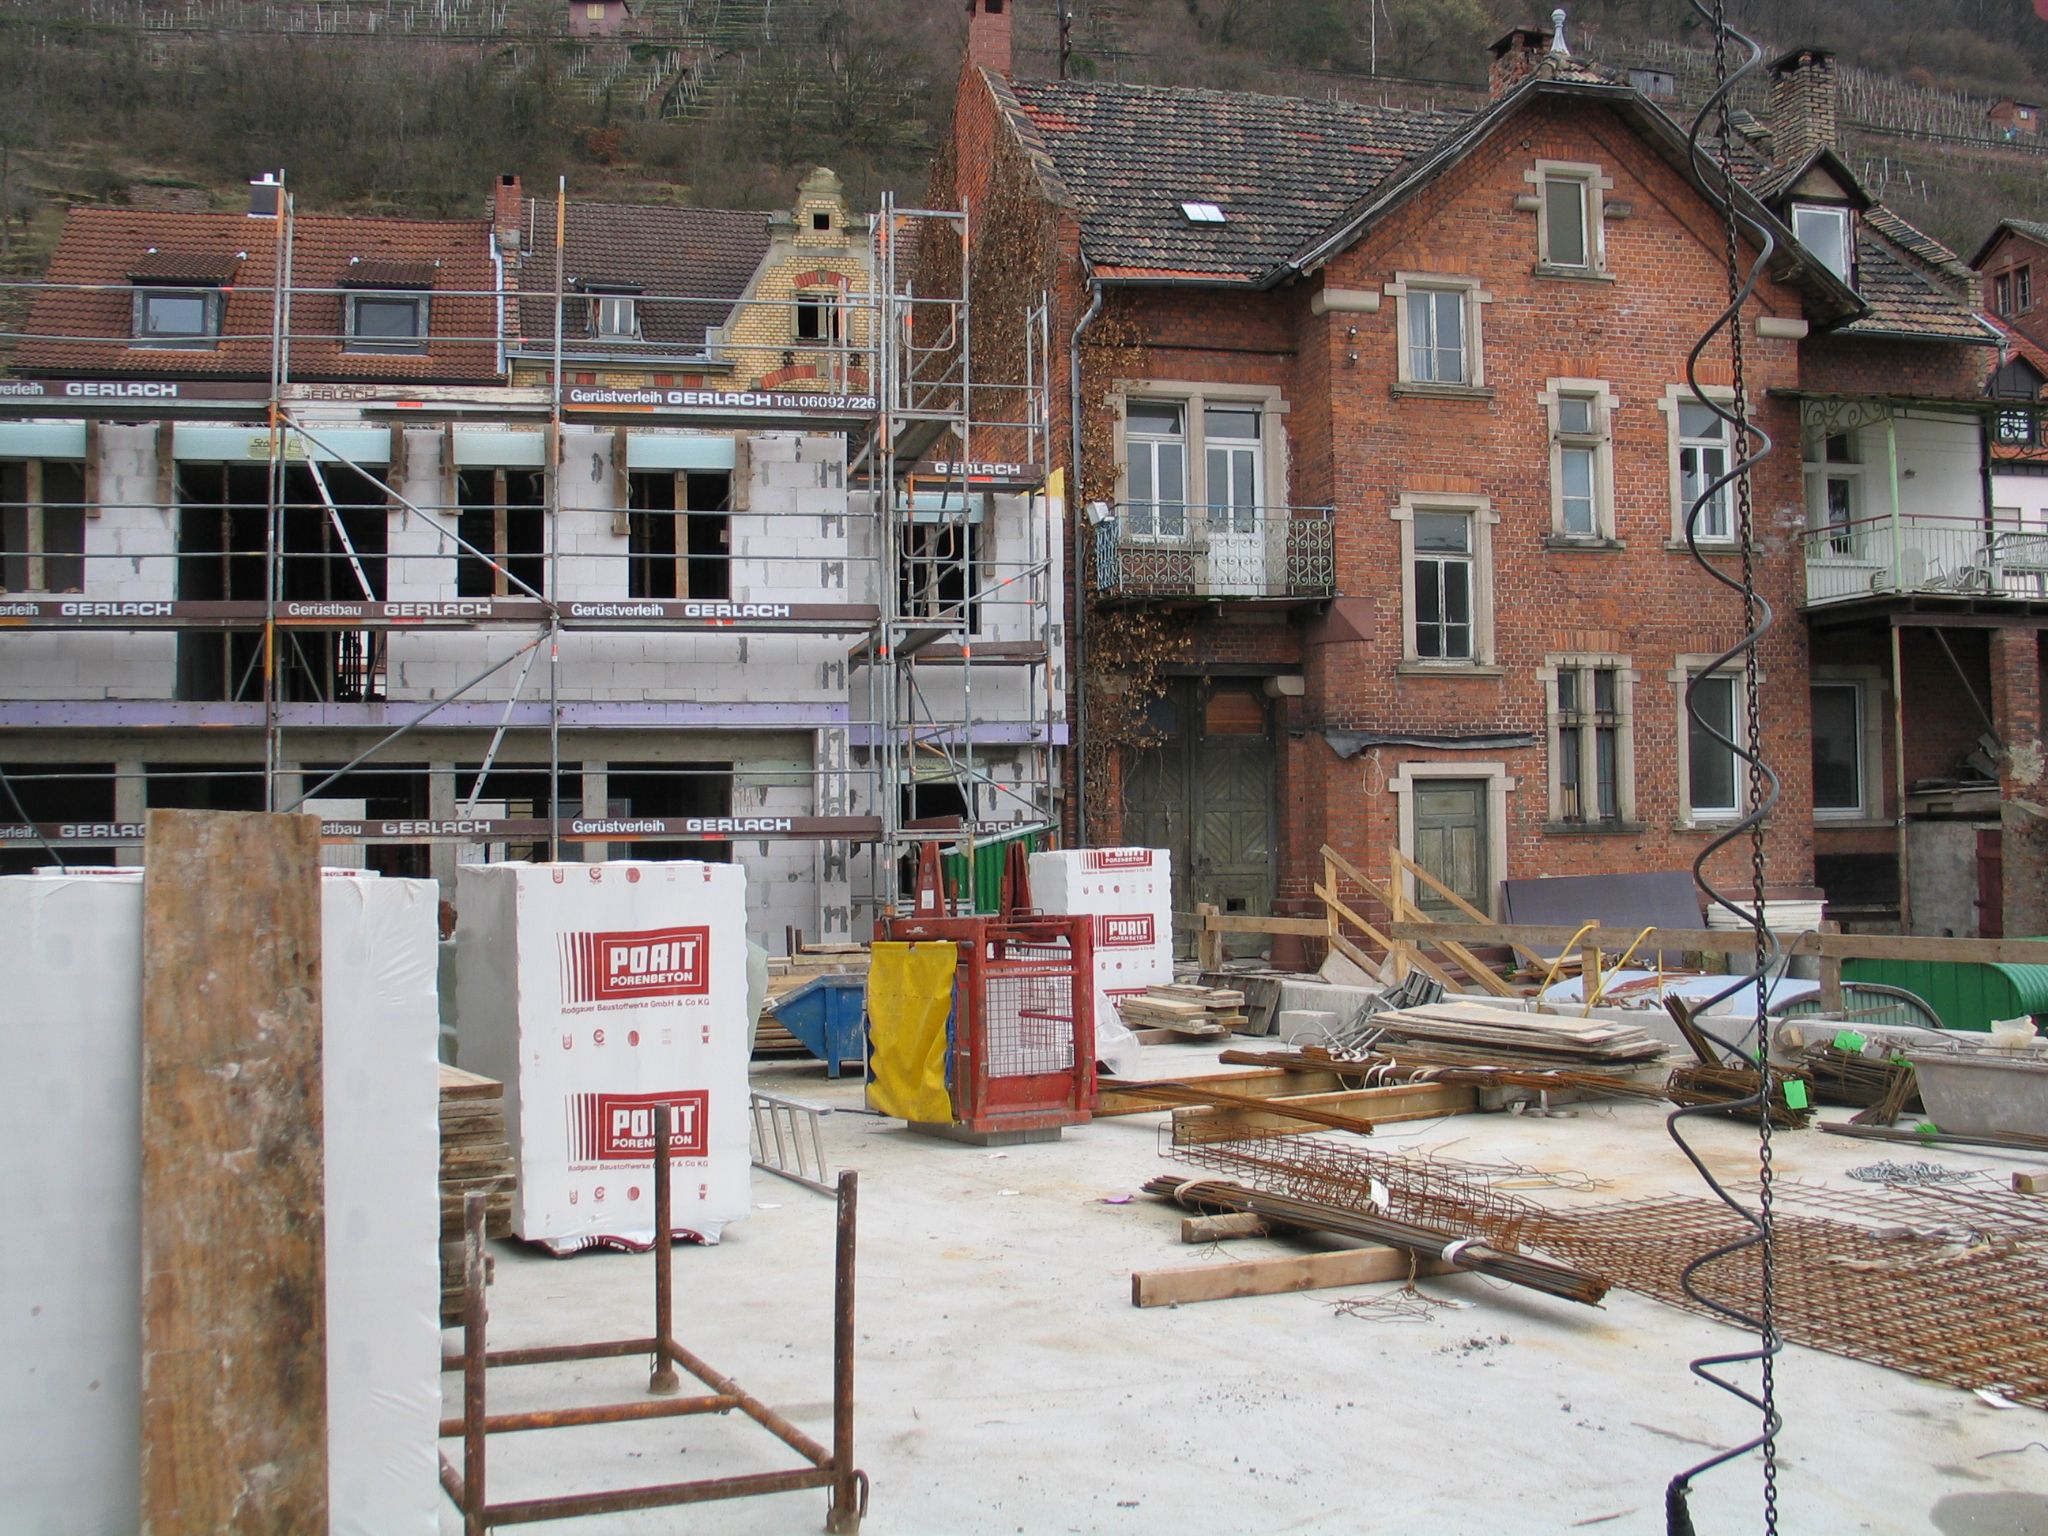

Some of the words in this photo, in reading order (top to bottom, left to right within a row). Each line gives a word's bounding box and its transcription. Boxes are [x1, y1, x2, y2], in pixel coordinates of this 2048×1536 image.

[66, 383, 177, 397] GERLACH
[570, 389, 663, 404] Gerüstverleih
[667, 391, 771, 406] GERLACH
[935, 463, 1020, 475] GERLACH
[61, 603, 173, 616] GERLACH
[288, 603, 362, 616] Gerüstbau
[384, 603, 492, 616] GERLACH
[571, 603, 664, 617] Gerüstverleih
[685, 604, 790, 617] GERLACH
[382, 821, 491, 834] GERLACH
[572, 820, 665, 833] Gerüstverleih
[686, 819, 791, 831] GERLACH
[1109, 920, 1148, 936] PORIT
[610, 941, 697, 975] PORIT
[610, 971, 693, 986] PORENBETON
[561, 1006, 595, 1015] Rodgauer
[597, 1002, 649, 1012] Baustoffwerke
[698, 998, 710, 1006] KG
[612, 1105, 695, 1137] POIT
